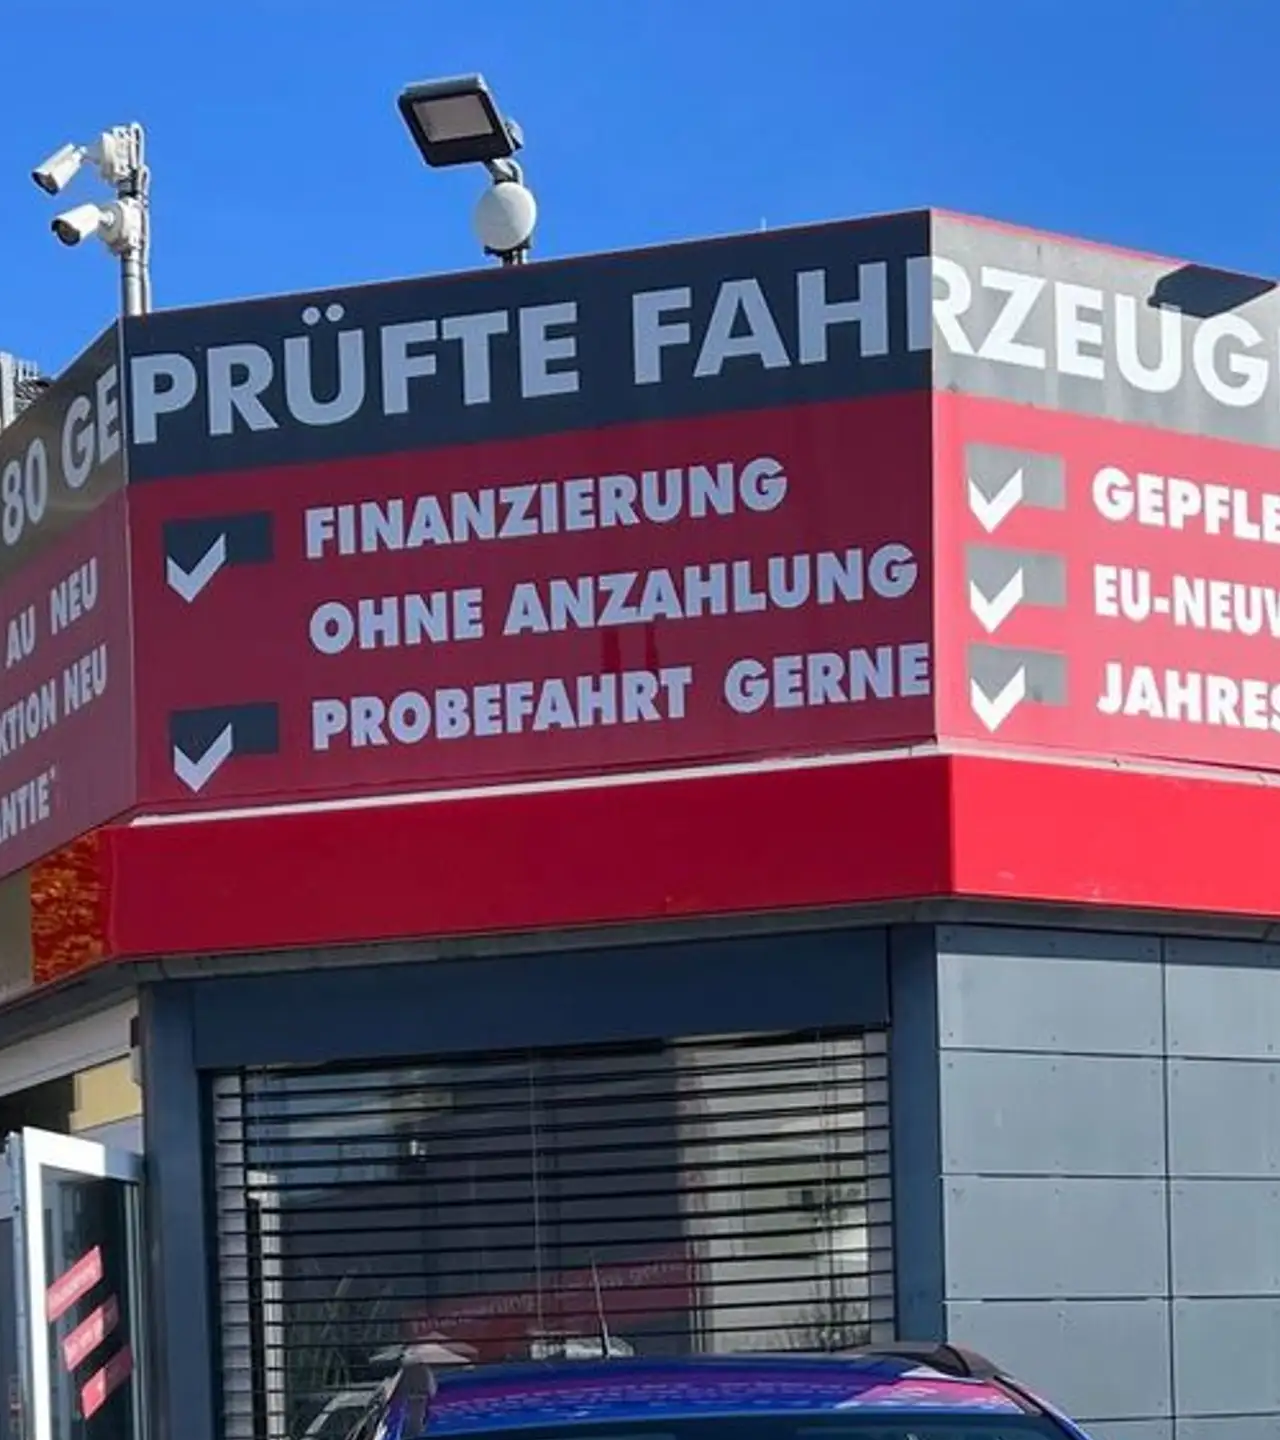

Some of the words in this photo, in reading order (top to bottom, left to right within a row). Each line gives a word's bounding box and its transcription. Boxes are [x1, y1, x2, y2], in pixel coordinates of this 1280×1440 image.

[2, 437, 48, 546] 80
[305, 457, 787, 559] FINANZIERUNG
[6, 604, 35, 669] AU
[50, 556, 98, 635] NEU
[309, 588, 483, 654] OHNE
[503, 543, 918, 636] ANZAHLUNG
[63, 643, 108, 716] NEU
[312, 666, 692, 751] PROBEFAHRT
[724, 642, 931, 714] GERNE
